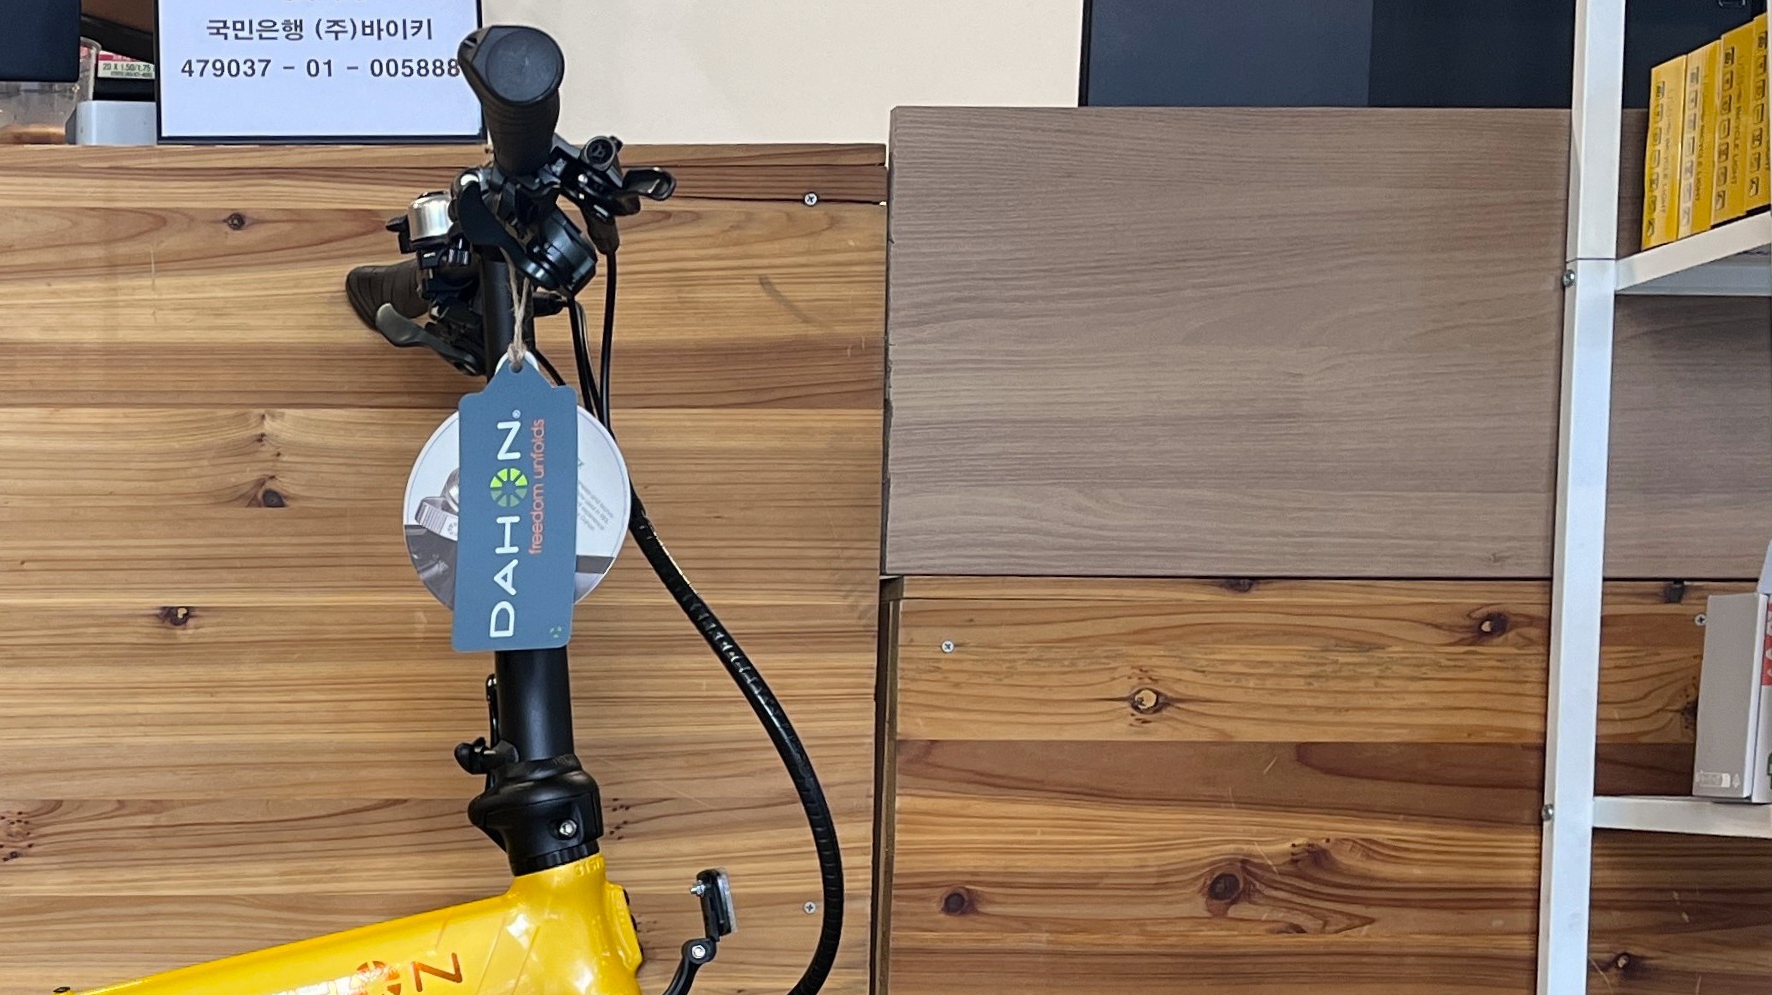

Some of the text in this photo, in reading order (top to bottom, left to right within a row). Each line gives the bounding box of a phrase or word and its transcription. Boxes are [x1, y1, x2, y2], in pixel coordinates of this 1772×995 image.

[206, 18, 433, 41] 국민은행 (주)바이키
[181, 58, 272, 78] 479037
[306, 58, 333, 78] 01
[370, 58, 461, 78] 005888
[529, 419, 545, 555] freedom unfolds
